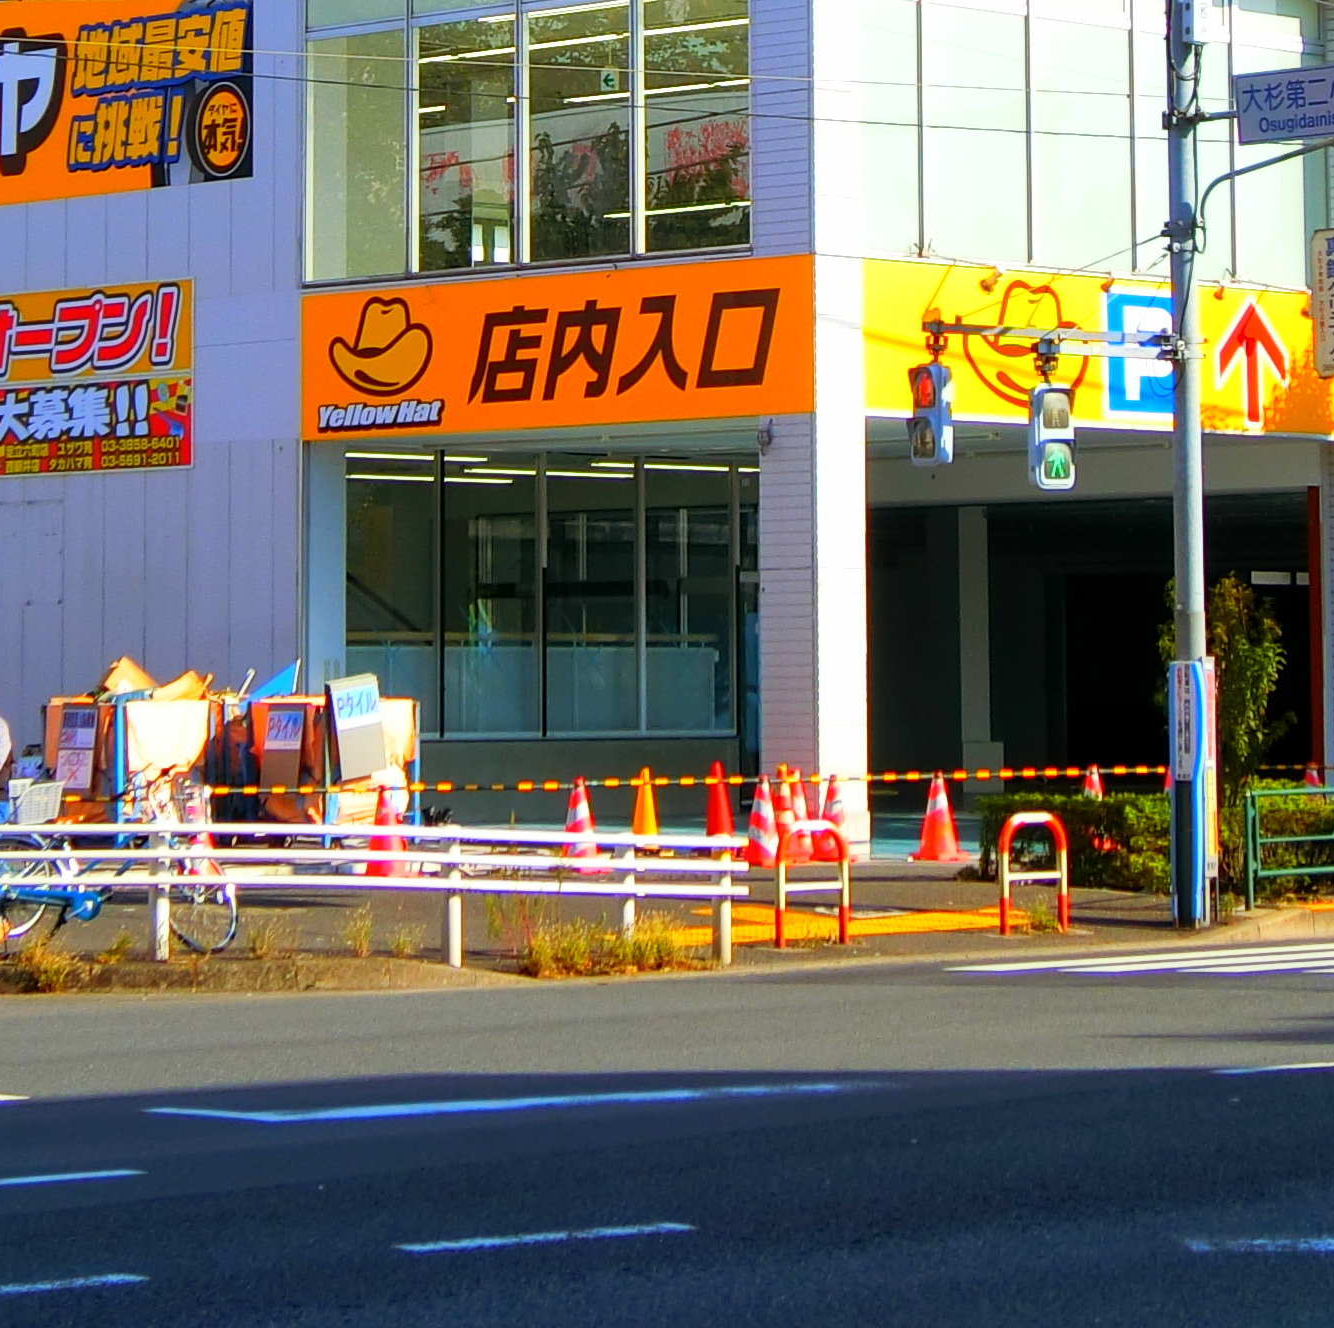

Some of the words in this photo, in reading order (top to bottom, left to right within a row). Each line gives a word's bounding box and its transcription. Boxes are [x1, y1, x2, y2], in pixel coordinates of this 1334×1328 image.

[73, 6, 249, 92] 地域最安値
[467, 287, 781, 406] 店内入口
[317, 399, 443, 432] YellowHat
